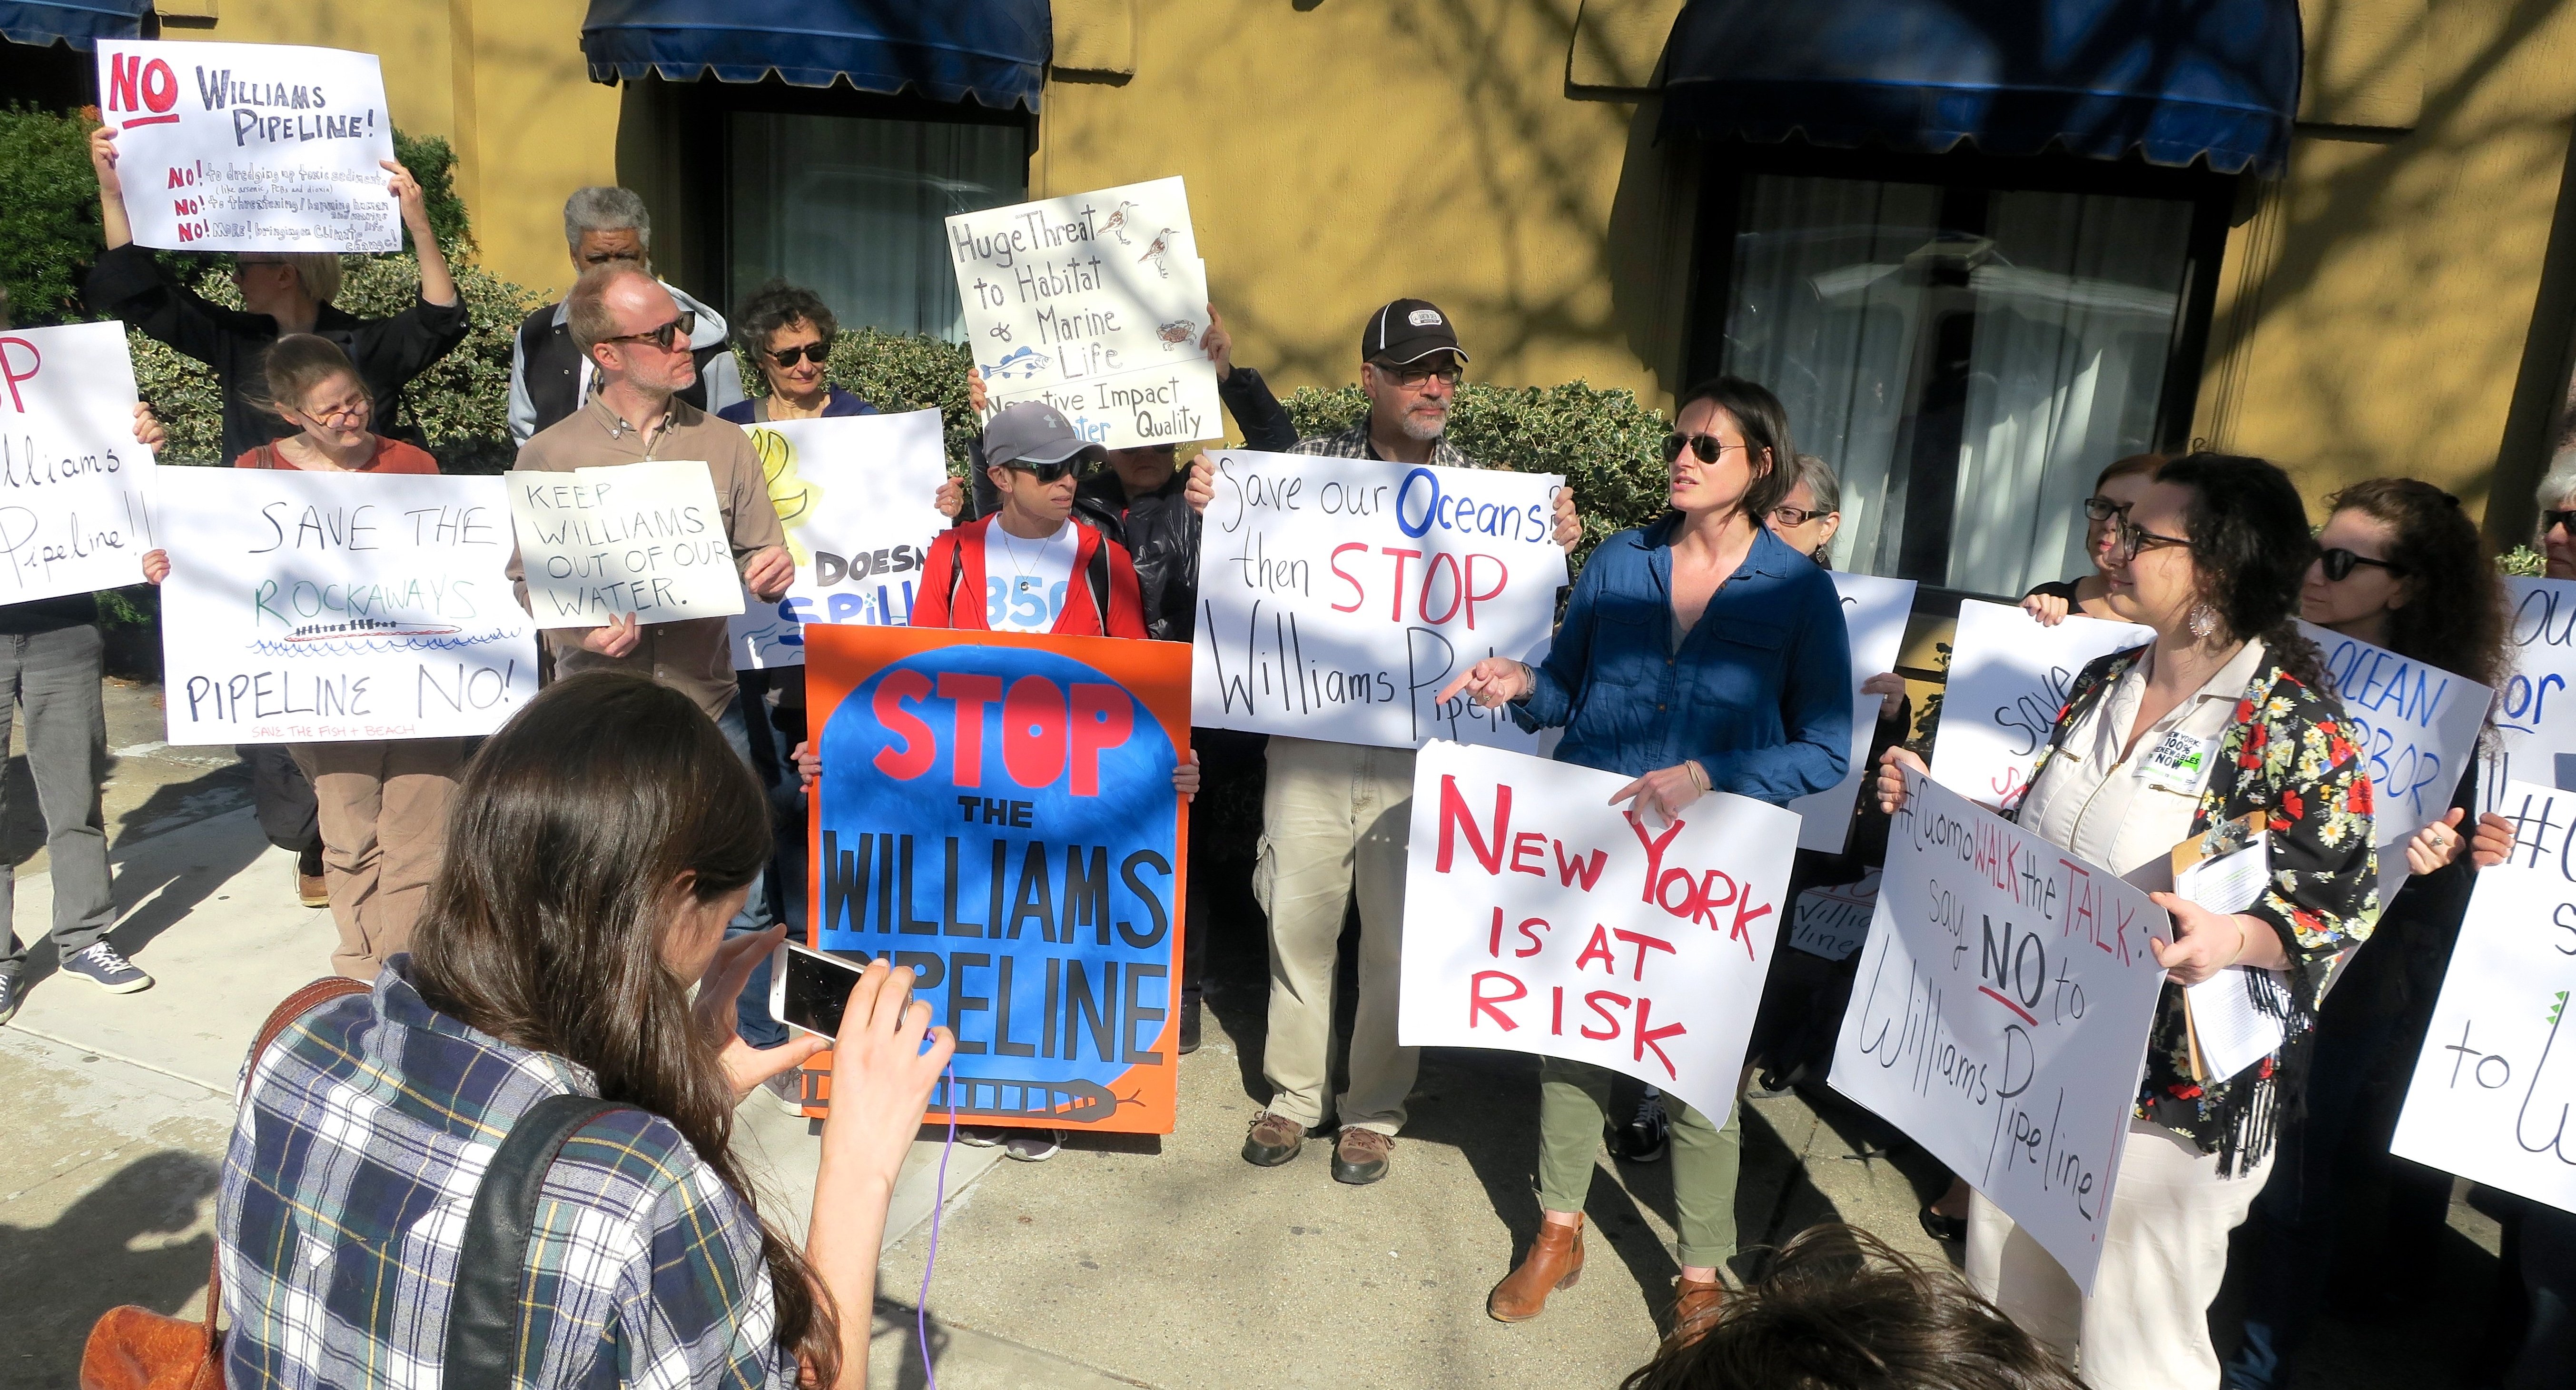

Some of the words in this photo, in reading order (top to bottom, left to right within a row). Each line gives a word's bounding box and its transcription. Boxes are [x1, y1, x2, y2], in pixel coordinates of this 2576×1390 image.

[109, 52, 178, 112] NO
[196, 66, 326, 110] WILLIAMS
[234, 109, 374, 146] PIPELINE!
[168, 160, 202, 189] NO!
[206, 162, 221, 181] to
[227, 162, 279, 184] dredging
[281, 170, 295, 183] up
[299, 164, 329, 180] toxic
[332, 169, 387, 186] sediments
[174, 195, 205, 216] NO!
[208, 196, 224, 208] to
[353, 199, 388, 210] human
[178, 219, 210, 242] NO!
[255, 222, 301, 240] bringing
[350, 213, 388, 221] marine
[952, 224, 1026, 268] Huge
[1016, 204, 1096, 249] Threat
[974, 278, 1004, 309] to
[1014, 255, 1101, 304] Habitat
[1036, 304, 1121, 344] Marine
[1058, 341, 1123, 379] Life
[1094, 377, 1179, 417] Impact
[1072, 415, 1111, 443] ater
[1136, 406, 1201, 438] Quality
[3, 434, 120, 488] lliams
[526, 483, 611, 509] KEEP
[1219, 457, 1302, 533] Save
[1320, 481, 1387, 516] our
[248, 502, 379, 553] SAVE
[407, 506, 497, 547] THE
[533, 506, 705, 546] WILLIAMS
[547, 553, 609, 578] OUT
[625, 546, 663, 573] OF
[674, 541, 734, 566] OUR
[1229, 526, 1309, 597] then
[1331, 542, 1508, 630] STOP
[255, 575, 476, 627] ROCKAWAYS
[548, 577, 688, 616] WATER.
[1205, 598, 1396, 716] Williams
[187, 671, 372, 724] PIPELINE
[418, 659, 514, 719] NO!
[2329, 641, 2448, 727] OCEAN
[252, 726, 285, 739] SAVE
[287, 726, 315, 737] THE
[319, 726, 347, 738] FISH
[365, 725, 416, 737] BEACH
[872, 668, 1134, 796] STOP
[2154, 746, 2200, 764] ENEWABLES
[2164, 738, 2192, 754] 100%
[2155, 754, 2183, 769] NOW
[957, 795, 1033, 828] THE
[823, 830, 1172, 949] WILLIAMS
[1436, 774, 1608, 893] NEW
[1622, 810, 1772, 963] YORK
[1489, 906, 1551, 958] IS
[1575, 923, 1677, 982] AT
[1930, 879, 1968, 971] say
[1982, 913, 2045, 1009] NO
[2055, 957, 2085, 1025] to
[1470, 970, 1687, 1081] RISK
[1860, 933, 1988, 1105] Williams
[2445, 1020, 2510, 1089] to
